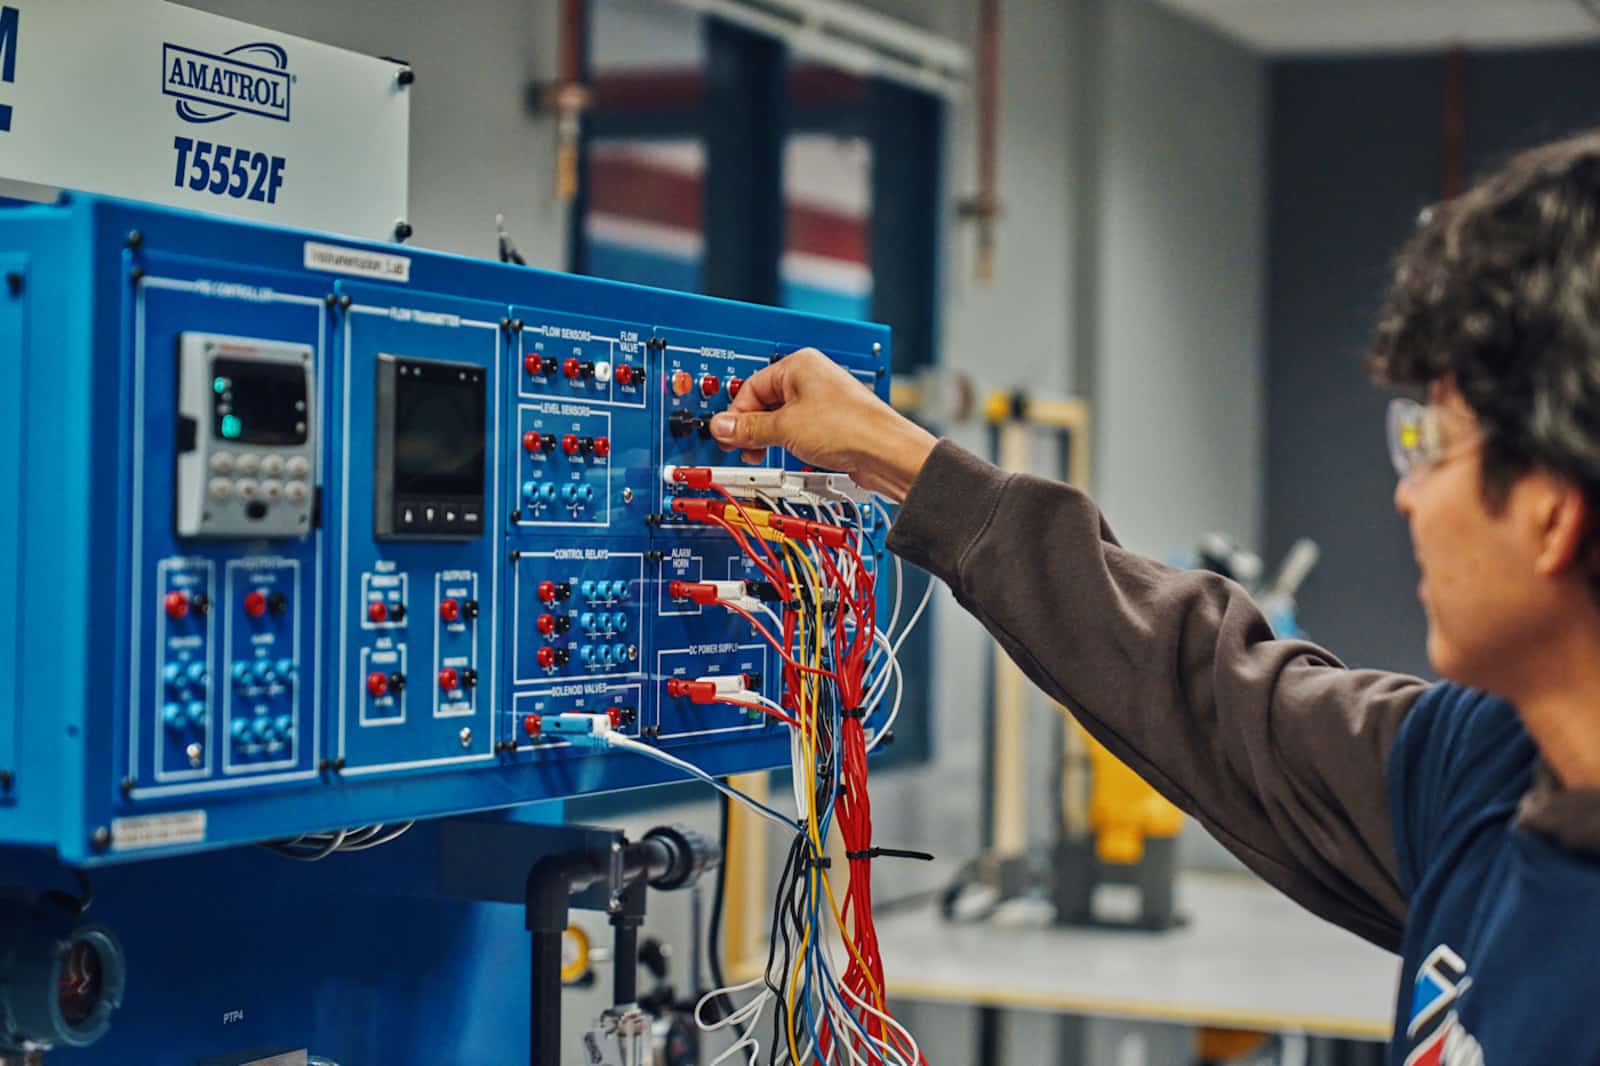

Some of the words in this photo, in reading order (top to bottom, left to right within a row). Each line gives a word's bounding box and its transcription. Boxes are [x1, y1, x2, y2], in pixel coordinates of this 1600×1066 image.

[168, 57, 285, 109] AMATROL
[173, 135, 287, 204] T5552F
[541, 324, 561, 338] FLOW
[561, 327, 591, 342] SENSORS
[620, 330, 639, 342] FLOW
[620, 341, 639, 354] VALVE
[540, 402, 560, 415] LEVEL
[561, 404, 591, 417] SENSORS
[554, 548, 584, 560] CONTROL
[585, 548, 609, 560] RELAYS
[671, 548, 692, 558] ALARM
[672, 558, 690, 569] HORN
[689, 645, 698, 656] DC
[698, 644, 717, 655] POWER
[551, 684, 583, 697] SOLENOID
[584, 682, 608, 694] VALVES
